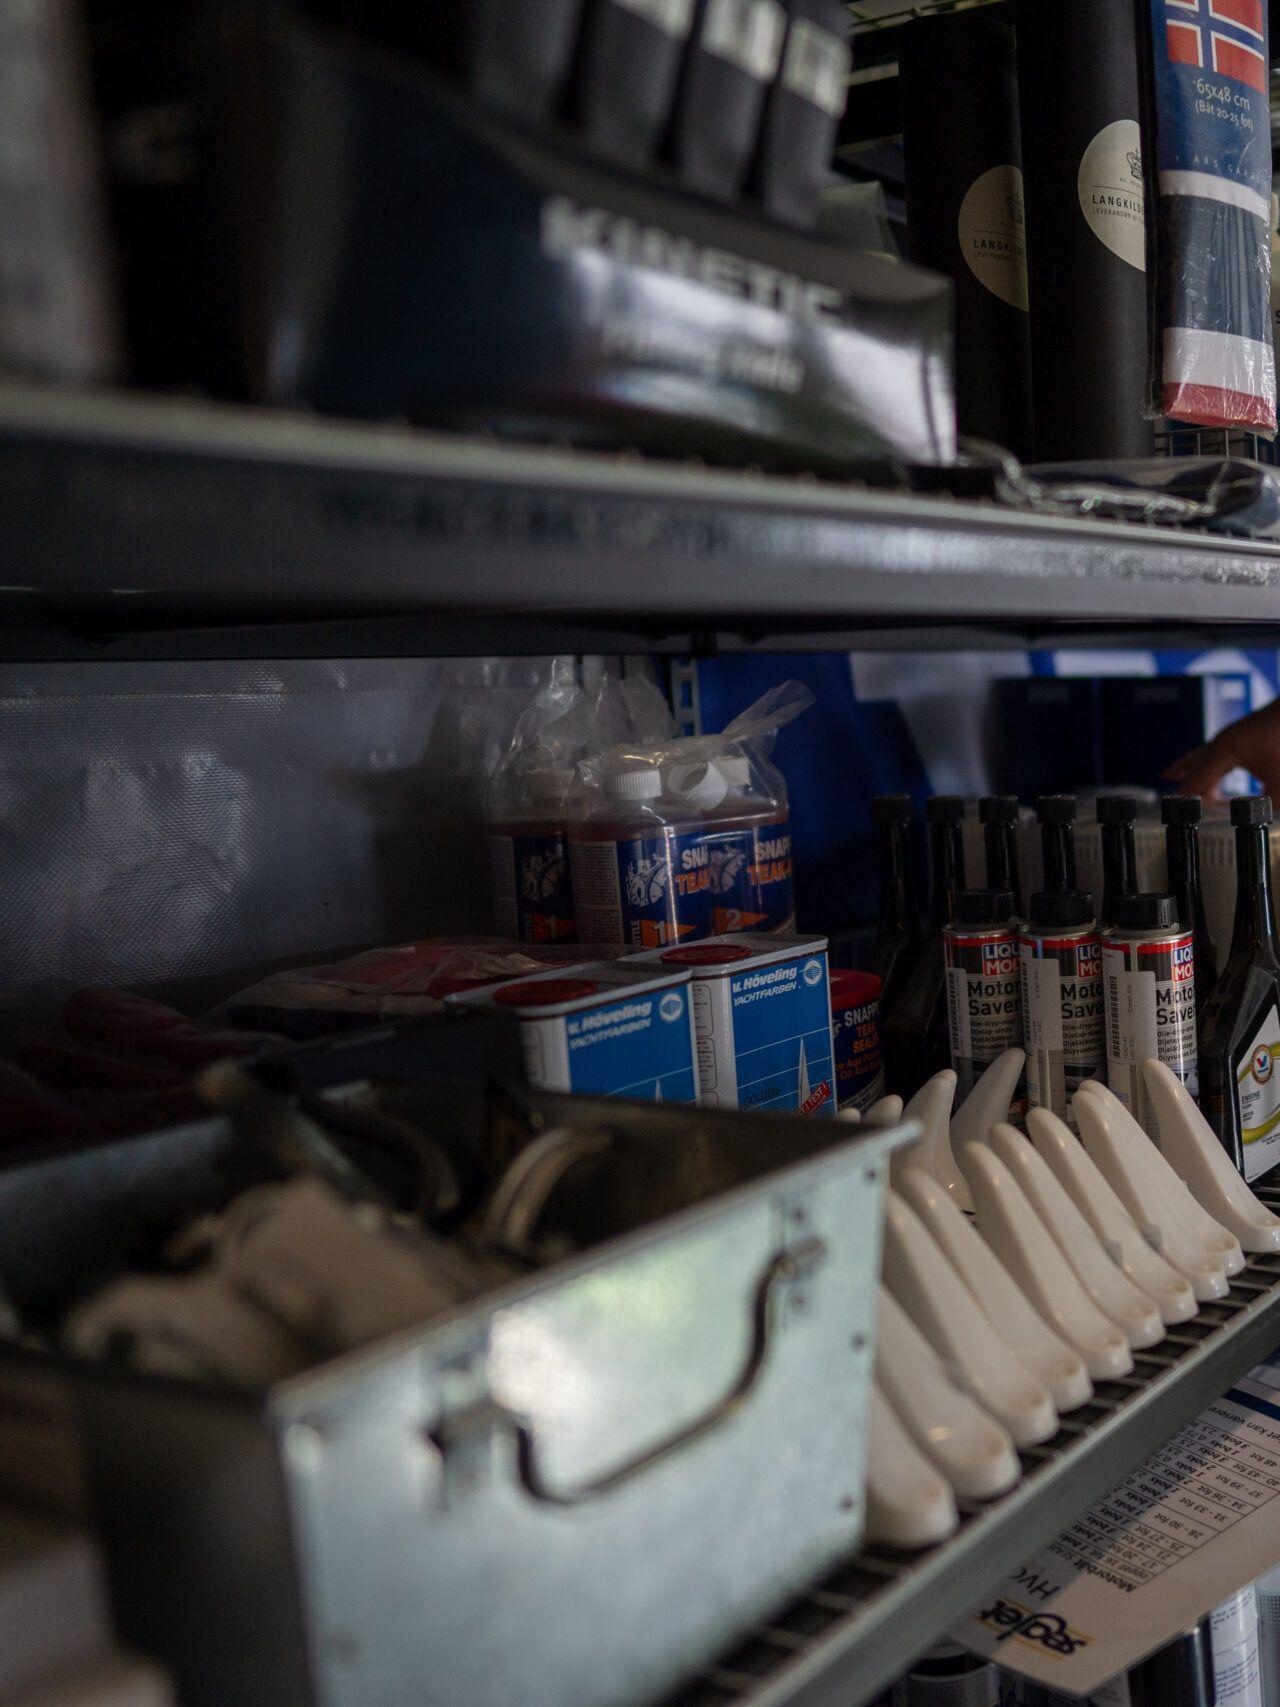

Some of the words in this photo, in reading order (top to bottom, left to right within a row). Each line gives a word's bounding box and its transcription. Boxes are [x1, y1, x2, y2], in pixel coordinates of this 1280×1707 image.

[1197, 79, 1231, 105] 65x48
[1234, 95, 1250, 110] cm
[725, 908, 742, 931] 2
[743, 966, 798, 990] Höveling
[733, 981, 798, 1006] YACHTFARBEN
[968, 999, 1021, 1017] Saver
[1208, 1406, 1245, 1424] variere
[1245, 1421, 1268, 1434] kan
[1210, 1439, 1232, 1452] boks
[1220, 1433, 1243, 1446] boks
[1197, 1446, 1220, 1459] boks
[1249, 1451, 1265, 1462] fot
[1175, 1460, 1197, 1473] boks
[1185, 1454, 1208, 1467] boks
[1232, 1462, 1248, 1472] fot
[1161, 1468, 1185, 1481] boks
[1150, 1476, 1172, 1489] boks
[1139, 1483, 1161, 1497] boks
[1114, 1498, 1137, 1512] boks
[1126, 1491, 1148, 1505] boks
[1099, 1507, 1123, 1521] boks
[1085, 1515, 1109, 1530] boks
[1071, 1524, 1095, 1539] boks
